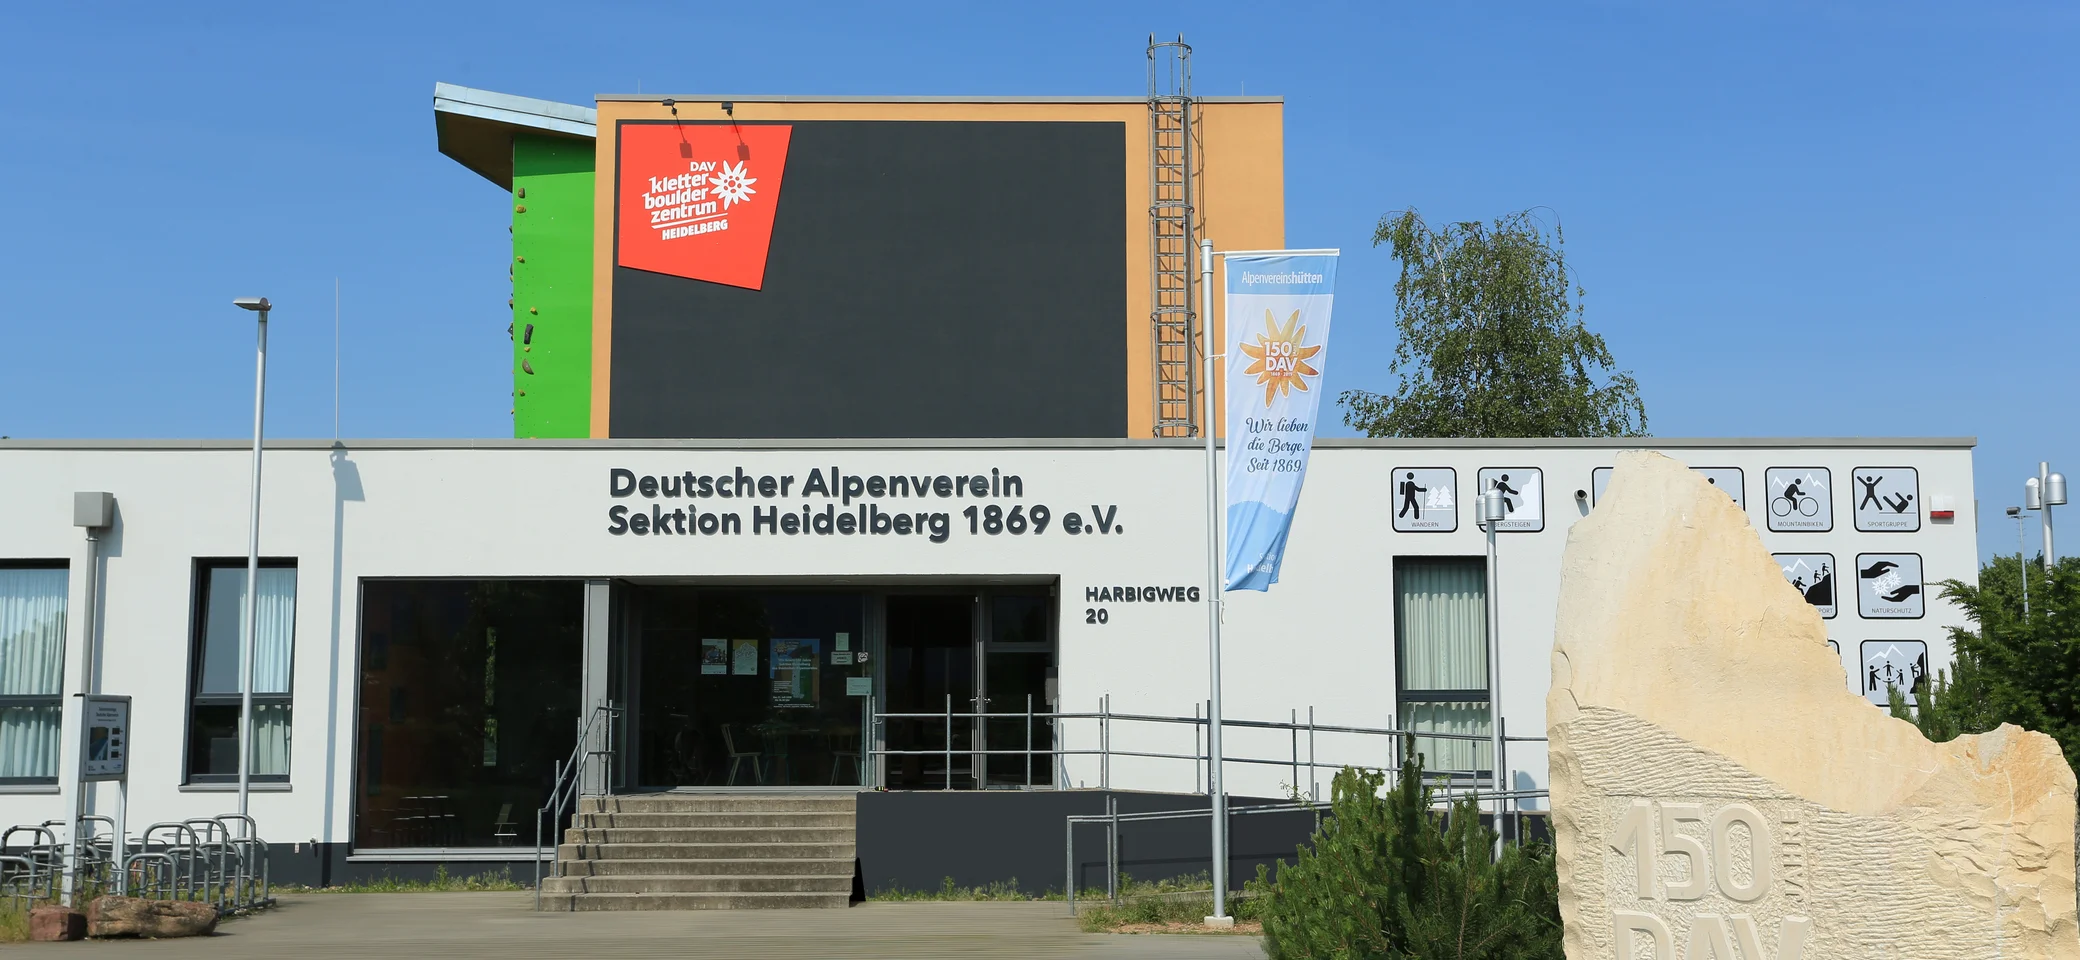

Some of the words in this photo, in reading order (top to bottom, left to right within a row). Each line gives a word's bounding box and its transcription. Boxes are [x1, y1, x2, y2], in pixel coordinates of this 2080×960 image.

[690, 161, 717, 172] DAV
[648, 172, 710, 194] kletter
[642, 187, 709, 210] boulder
[650, 201, 717, 224] zentrum
[662, 219, 729, 241] HEIDELBERG
[1241, 271, 1323, 287] Alpenvereinshütten
[1264, 341, 1293, 357] 150
[1265, 357, 1298, 371] DAV
[1245, 417, 1274, 434] Wir
[1277, 417, 1309, 432] lieben
[1247, 437, 1265, 452] die
[1268, 439, 1305, 456] Berge.
[1247, 457, 1269, 474] Seit
[1272, 459, 1303, 473] 1869.
[608, 467, 795, 499] Deutscher
[801, 466, 1024, 505] Alpenverein
[607, 504, 742, 536] Sektion
[752, 503, 951, 543] Heidelberg
[962, 504, 1052, 536] 1869
[1062, 505, 1125, 537] e.V.
[1085, 586, 1201, 604] HARBIGWEG
[1085, 608, 1110, 626] 20
[1609, 800, 1772, 903] 150
[1780, 808, 1808, 903] JAHRE
